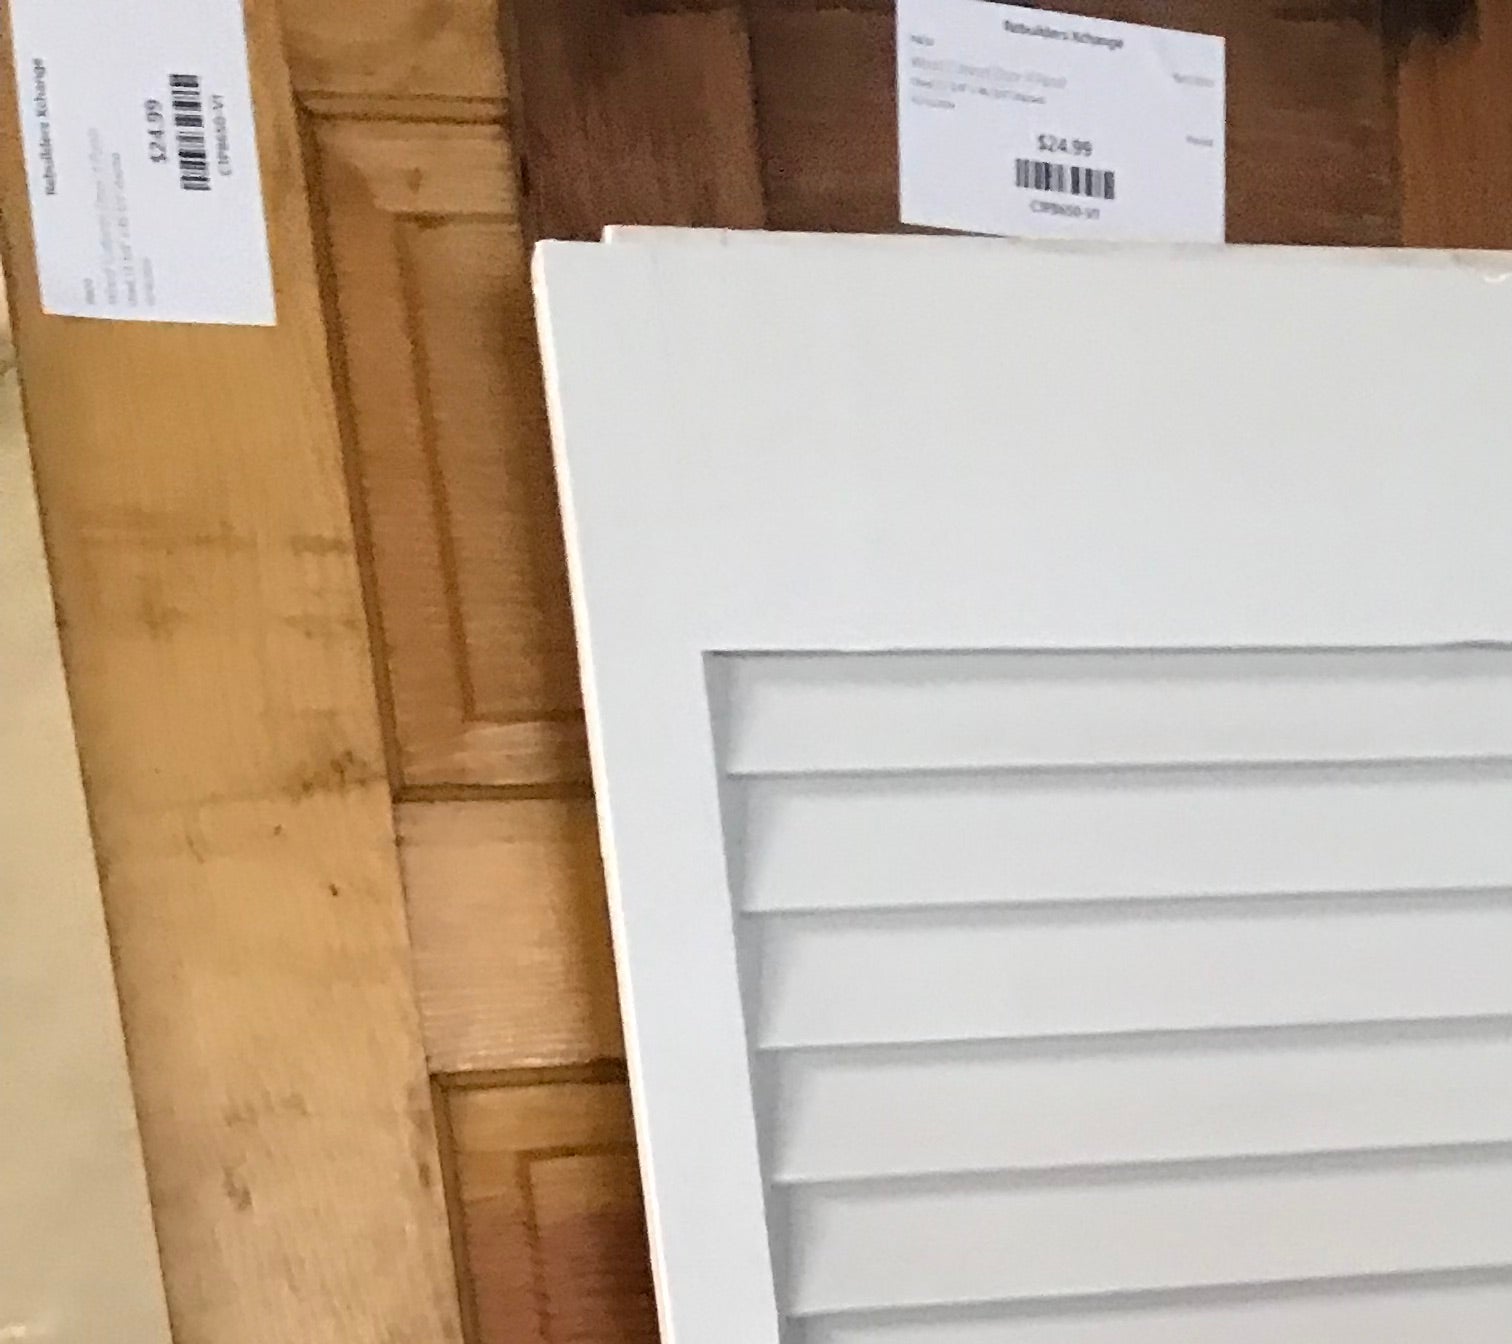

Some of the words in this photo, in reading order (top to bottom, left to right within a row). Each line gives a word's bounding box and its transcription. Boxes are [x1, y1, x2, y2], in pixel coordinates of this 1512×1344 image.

[1072, 31, 1124, 50] Xchange
[32, 58, 48, 118] Xchange
[39, 121, 57, 195] Rebuilders
[144, 99, 168, 163] $24.99
[1037, 134, 1093, 157] $24.99
